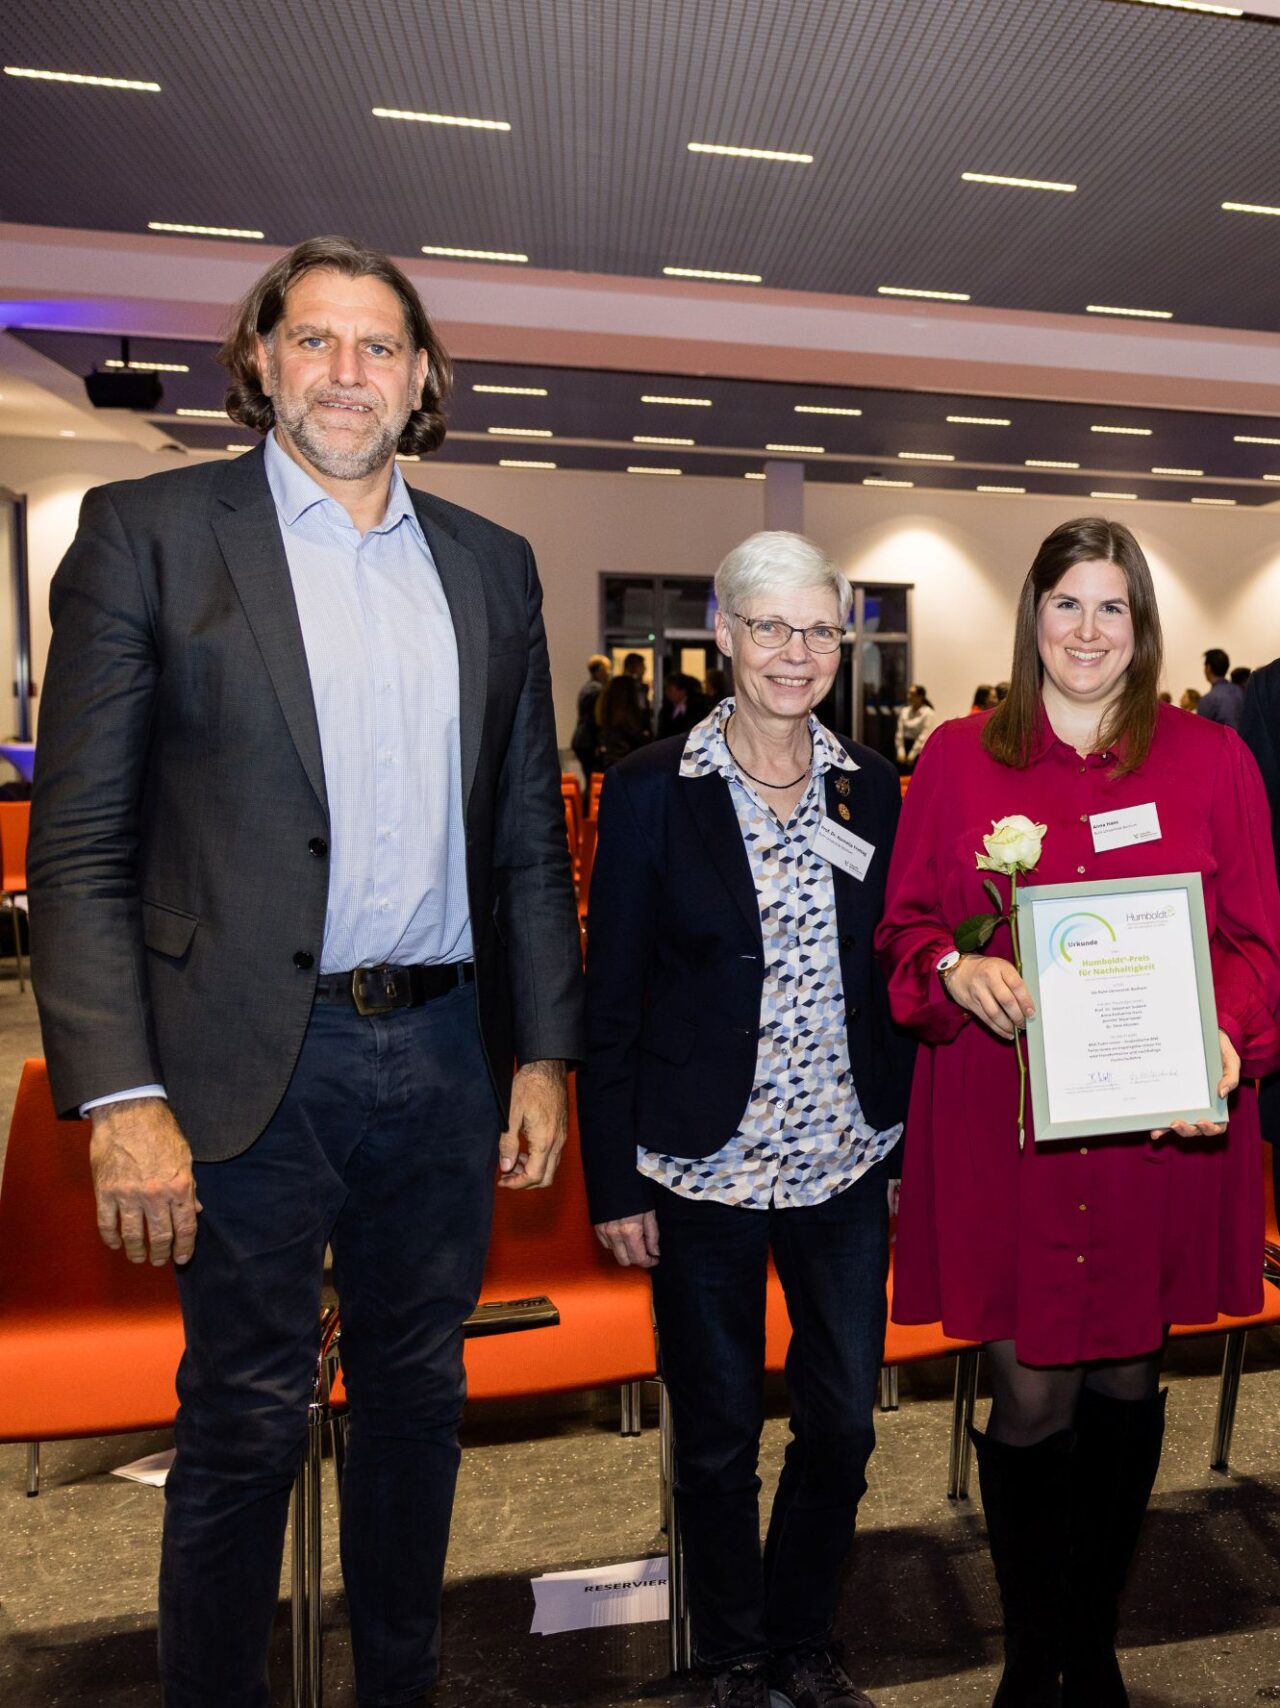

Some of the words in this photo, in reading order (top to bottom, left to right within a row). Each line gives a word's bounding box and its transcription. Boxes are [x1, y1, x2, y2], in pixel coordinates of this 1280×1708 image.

[1067, 939, 1099, 948] Urkunde
[1078, 968, 1091, 977] für
[1093, 963, 1156, 977] Nachhaltigkeit
[583, 1578, 668, 1593] RESERVIER
